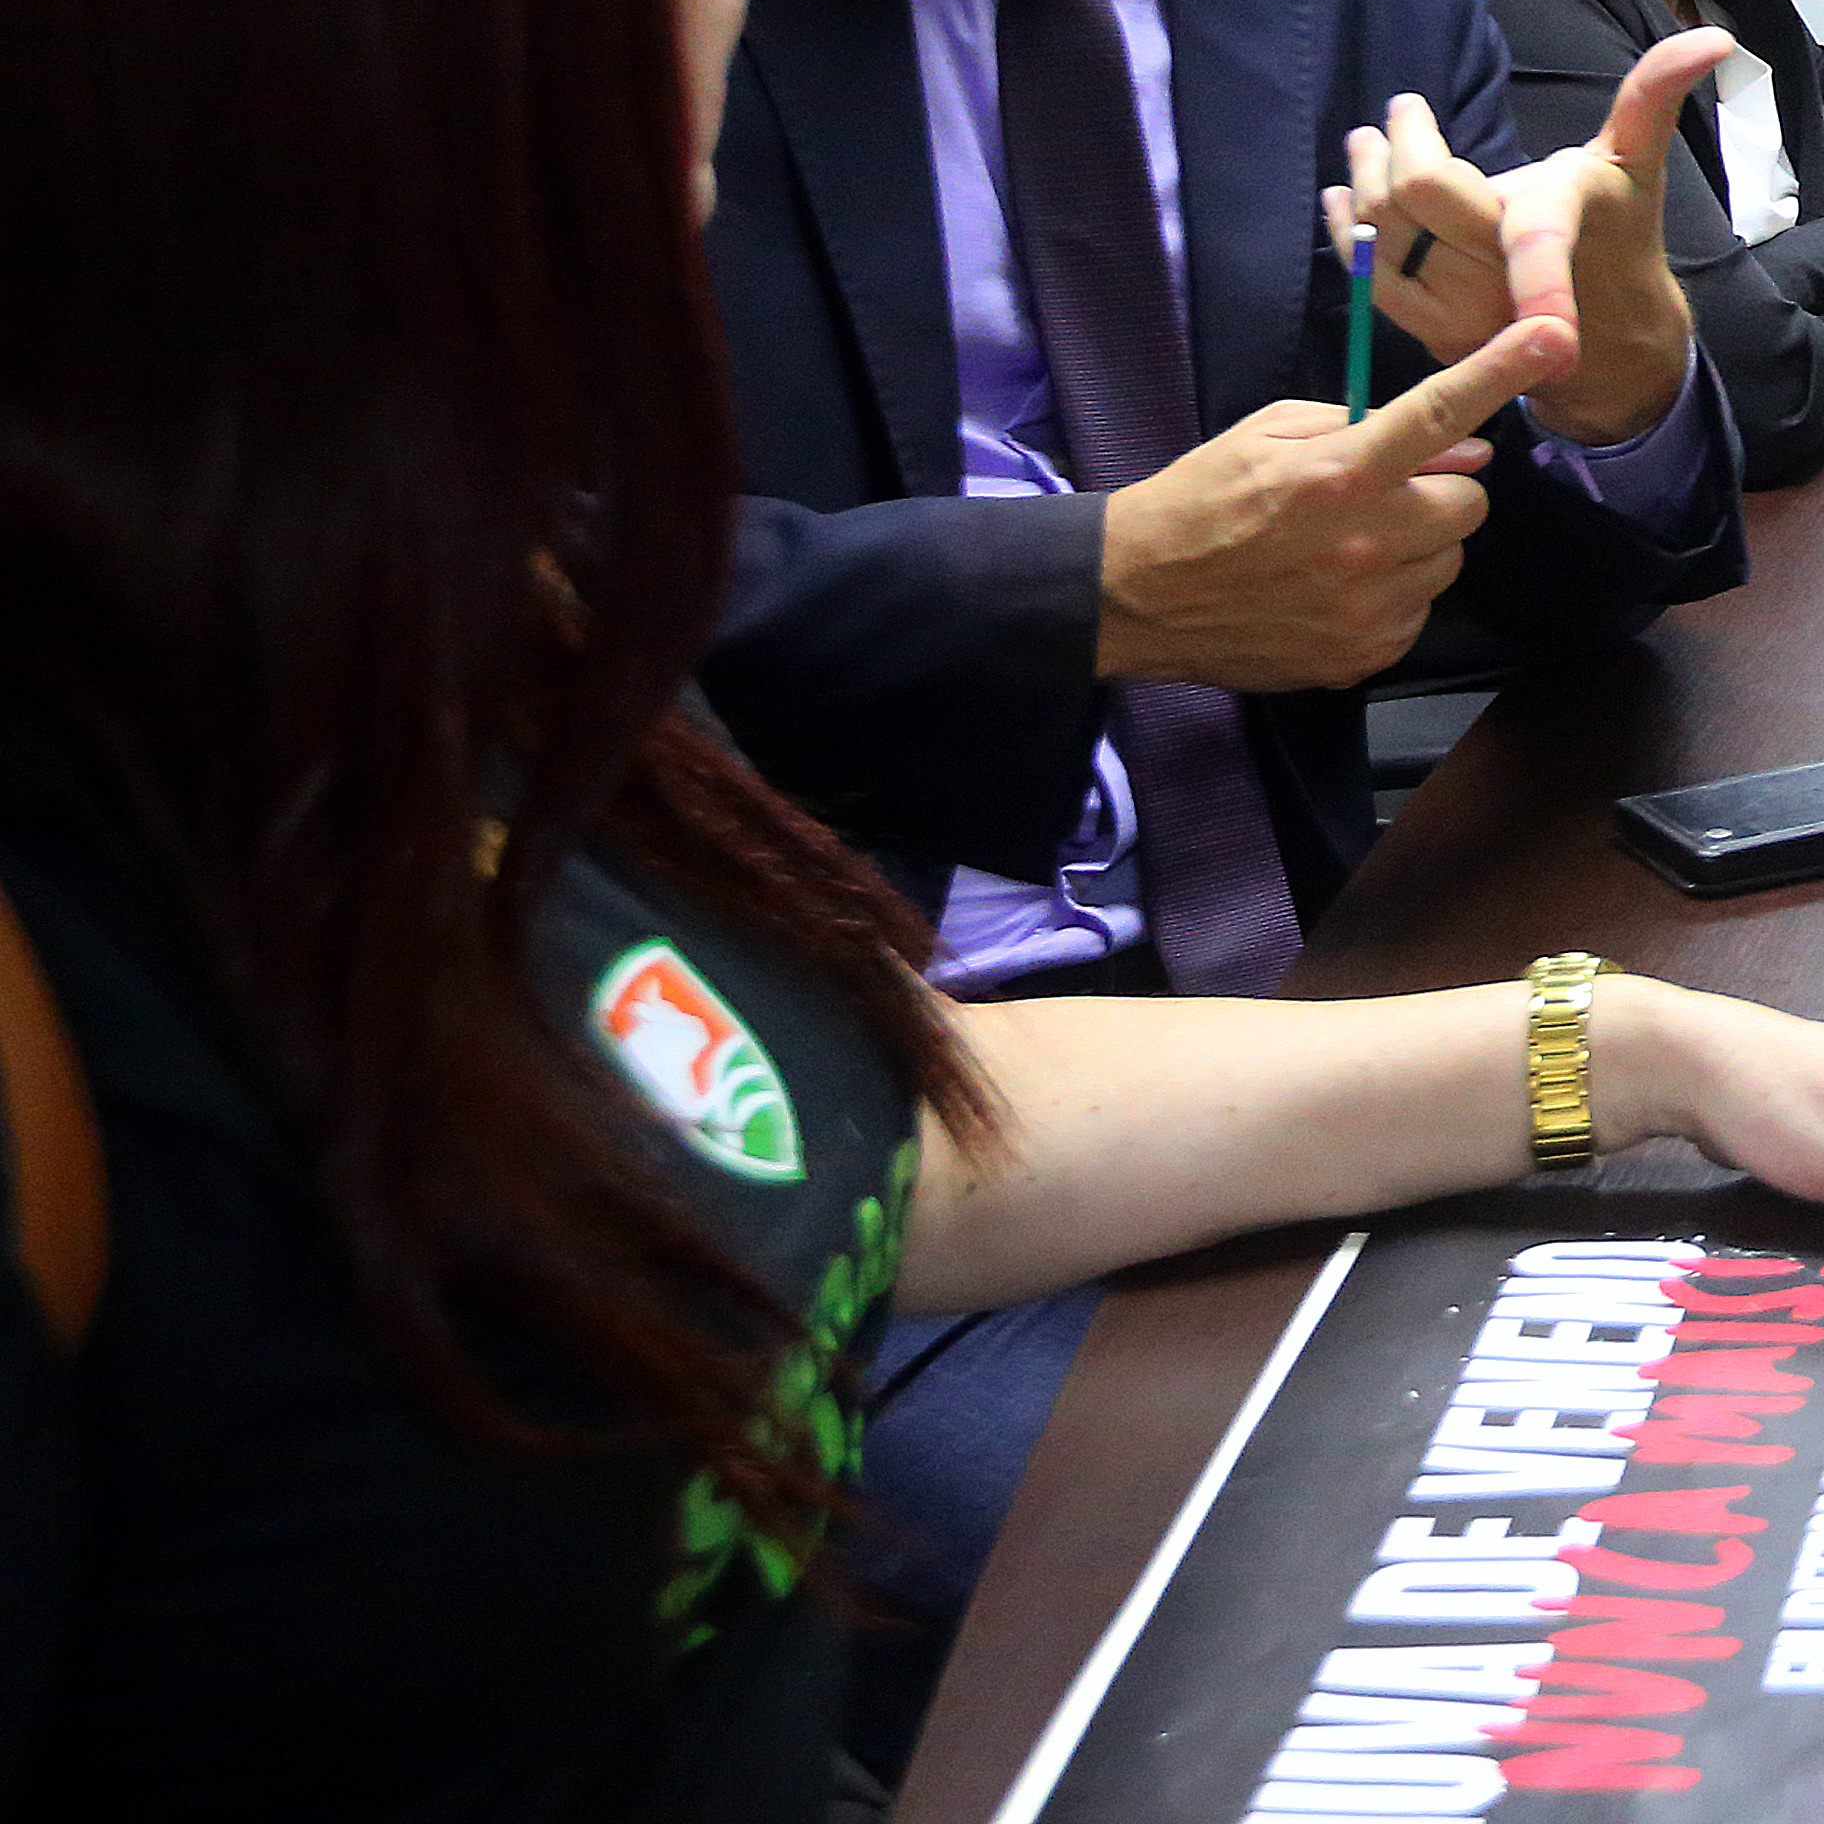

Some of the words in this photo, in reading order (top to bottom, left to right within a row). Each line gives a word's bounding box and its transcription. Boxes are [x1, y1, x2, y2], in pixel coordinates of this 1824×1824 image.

[1404, 1239, 1707, 1504] VENENO
[1346, 1514, 1606, 1627] DE
[1477, 1484, 1770, 1791] NUNCA
